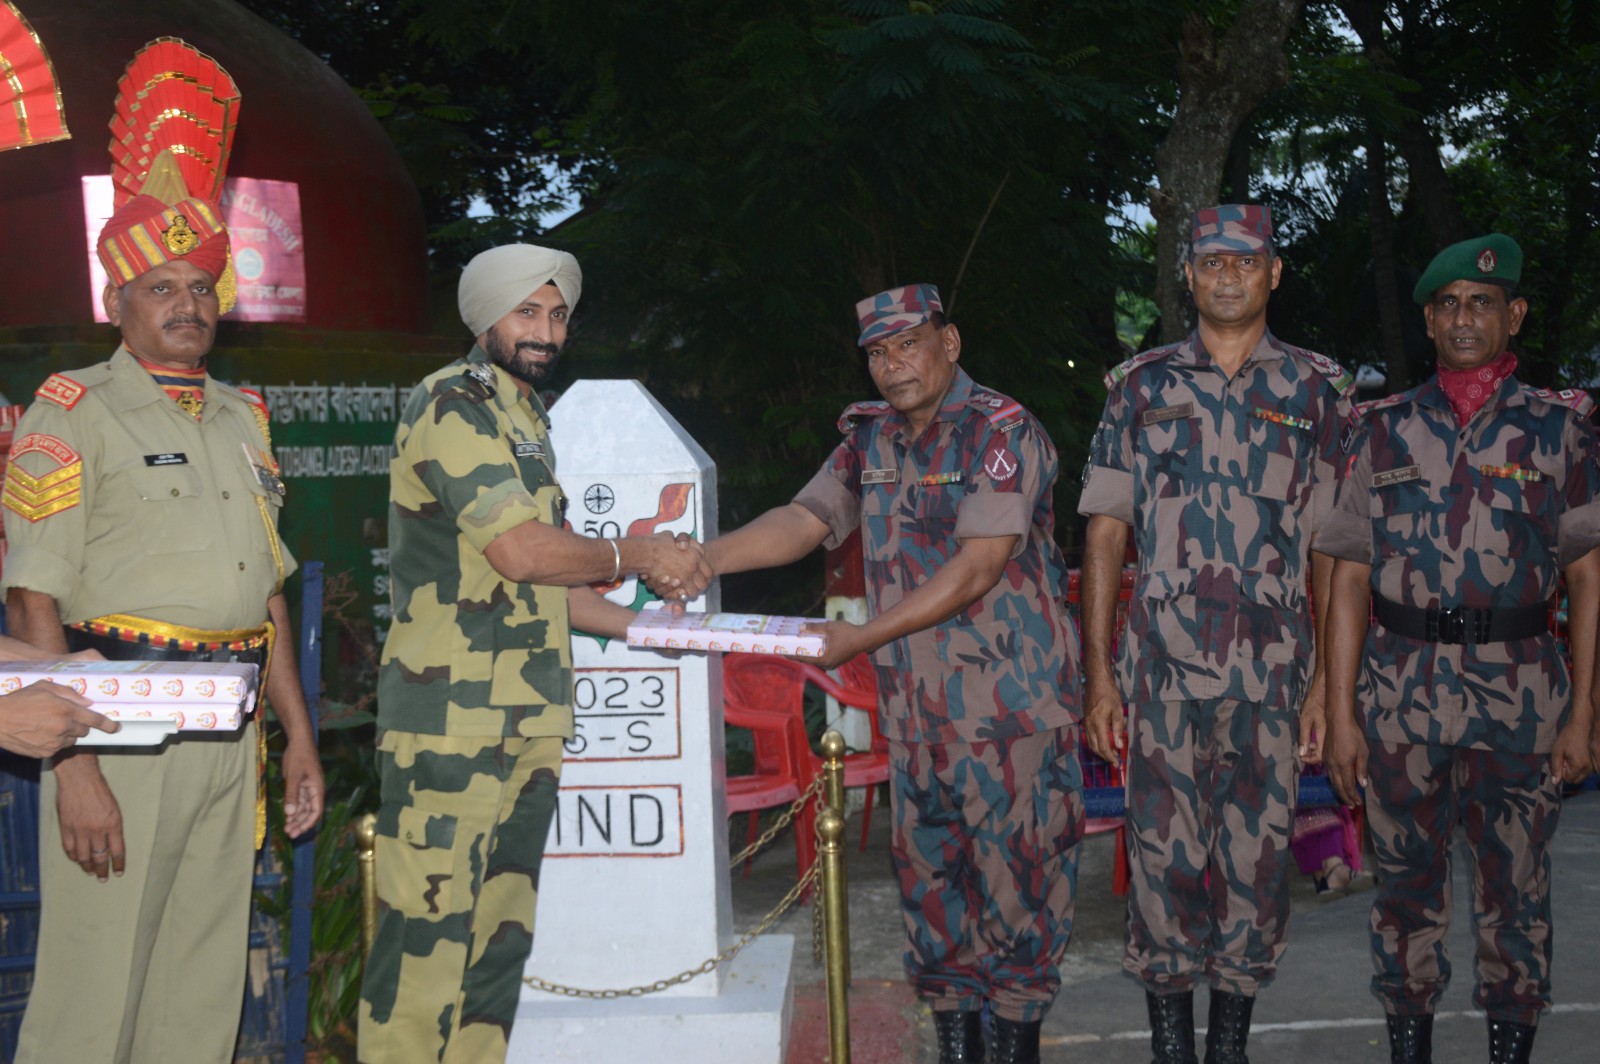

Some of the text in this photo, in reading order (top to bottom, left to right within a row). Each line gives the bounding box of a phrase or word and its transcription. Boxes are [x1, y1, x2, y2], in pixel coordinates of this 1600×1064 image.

[220, 187, 300, 251] ANGLADESH
[574, 676, 665, 709] 023
[556, 793, 664, 847] IND
